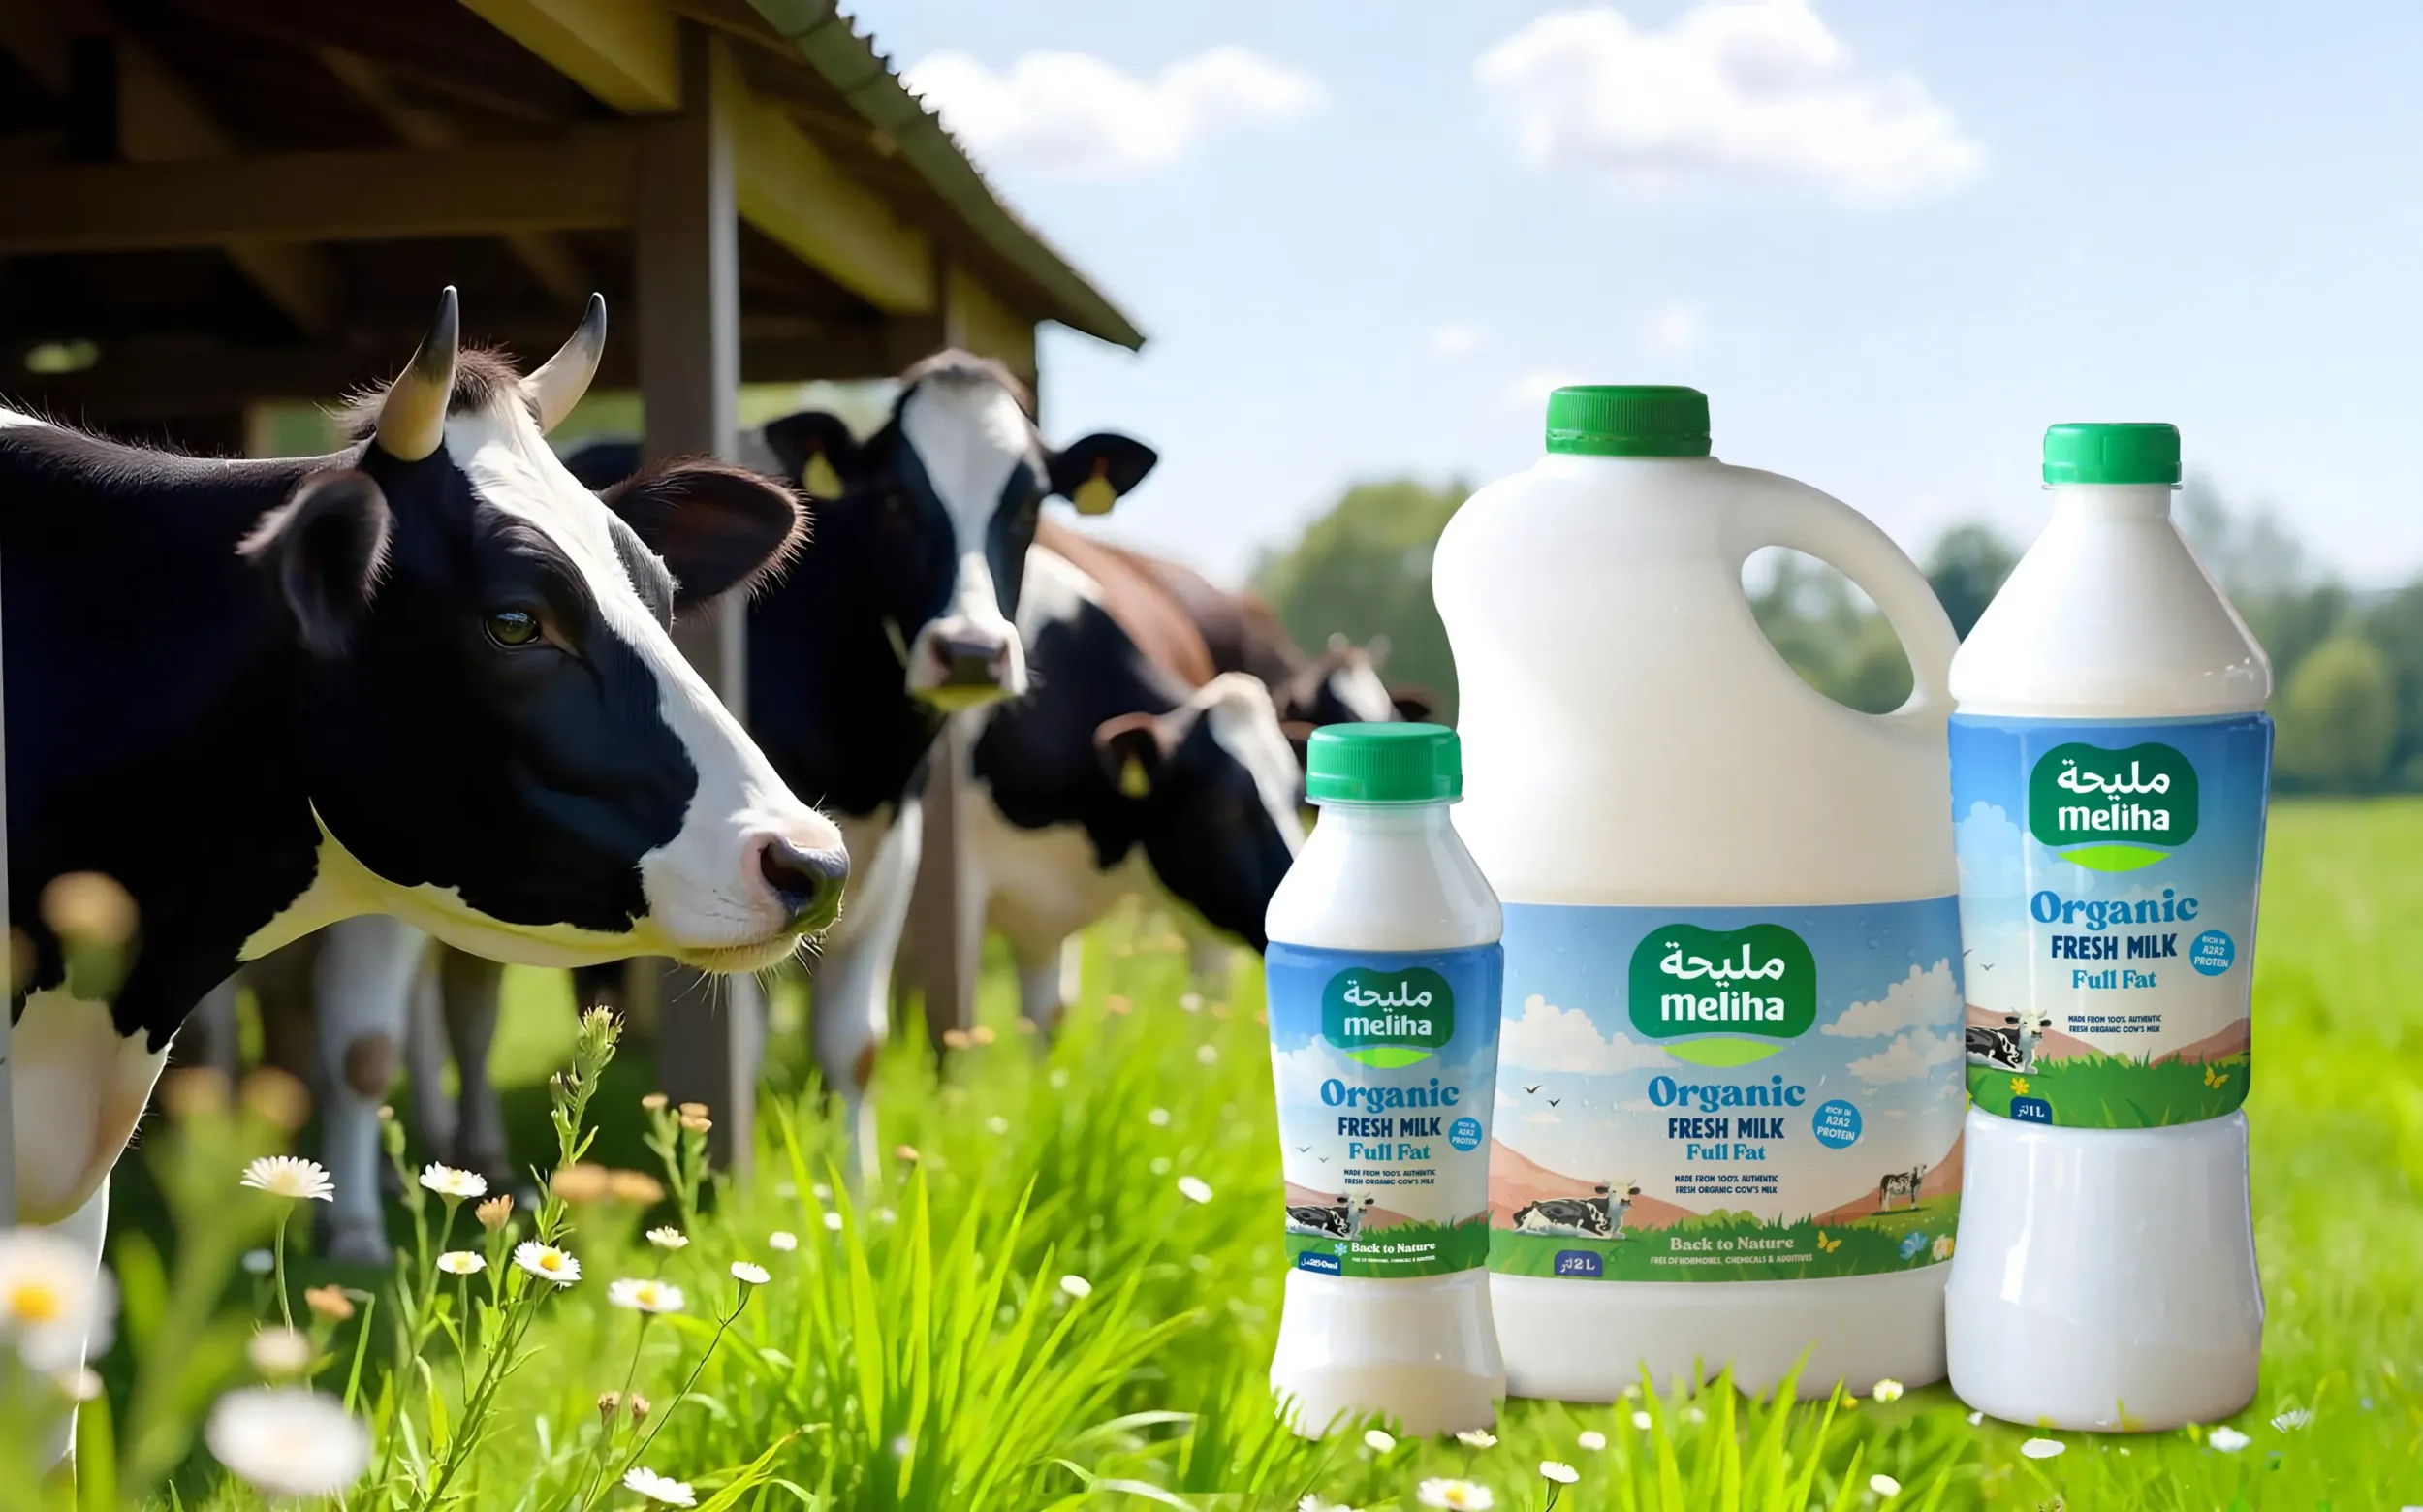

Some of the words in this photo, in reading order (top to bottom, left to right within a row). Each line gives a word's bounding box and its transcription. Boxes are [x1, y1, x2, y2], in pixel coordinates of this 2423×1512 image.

[2057, 759, 2170, 801] مليحة
[2058, 803, 2170, 831] meliha
[2030, 888, 2198, 931] Organic
[2051, 935, 2118, 960] FRESH
[2127, 933, 2178, 959] MILK
[2202, 945, 2224, 956] A2A2
[1659, 940, 1785, 988] مليحة
[2194, 956, 2229, 967] PROTEIN
[2072, 969, 2117, 989] Full
[2122, 969, 2156, 989] Fat
[1343, 979, 1432, 1013] مليحة
[1661, 991, 1784, 1021] meliha
[1344, 1015, 1432, 1036] meliha
[2087, 1015, 2105, 1024] FROM
[2128, 1014, 2161, 1023] AUTHENTIC
[1320, 1077, 1460, 1114] Organic
[1648, 1074, 1806, 1113] Organic
[1825, 1105, 1842, 1116] RICH
[1843, 1108, 1852, 1117] IN
[2036, 1106, 2045, 1118] L
[1338, 1117, 1393, 1137] FRESH
[1400, 1117, 1442, 1137] MILK
[1668, 1118, 1728, 1139] FRESH
[1738, 1118, 1785, 1139] MILK
[1825, 1115, 1850, 1127] A2A2
[1458, 1127, 1475, 1136] A2A2
[1816, 1125, 1856, 1141] PROTEIN
[1451, 1136, 1478, 1146] PROTEIN
[1349, 1142, 1392, 1160] Full
[1397, 1143, 1431, 1160] Fat
[1686, 1143, 1728, 1160] Full
[1733, 1143, 1766, 1160] Fat
[1675, 1185, 1696, 1194] FRESH
[1698, 1185, 1733, 1194] ORGANIC
[1734, 1185, 1759, 1194] COW'S
[1761, 1185, 1778, 1194] MILK
[1351, 1242, 1380, 1253] Back
[1382, 1244, 1395, 1254] to
[1397, 1242, 1436, 1253] Nature
[1670, 1237, 1713, 1251] Back
[1716, 1239, 1734, 1250] to
[1737, 1236, 1794, 1250] Nature
[1573, 1258, 1584, 1270] 2
[1586, 1258, 1596, 1270] L
[1651, 1256, 1667, 1265] FREE
[1725, 1255, 1767, 1264] CHEMICALS
[1776, 1253, 1813, 1263] ADDITIVES
